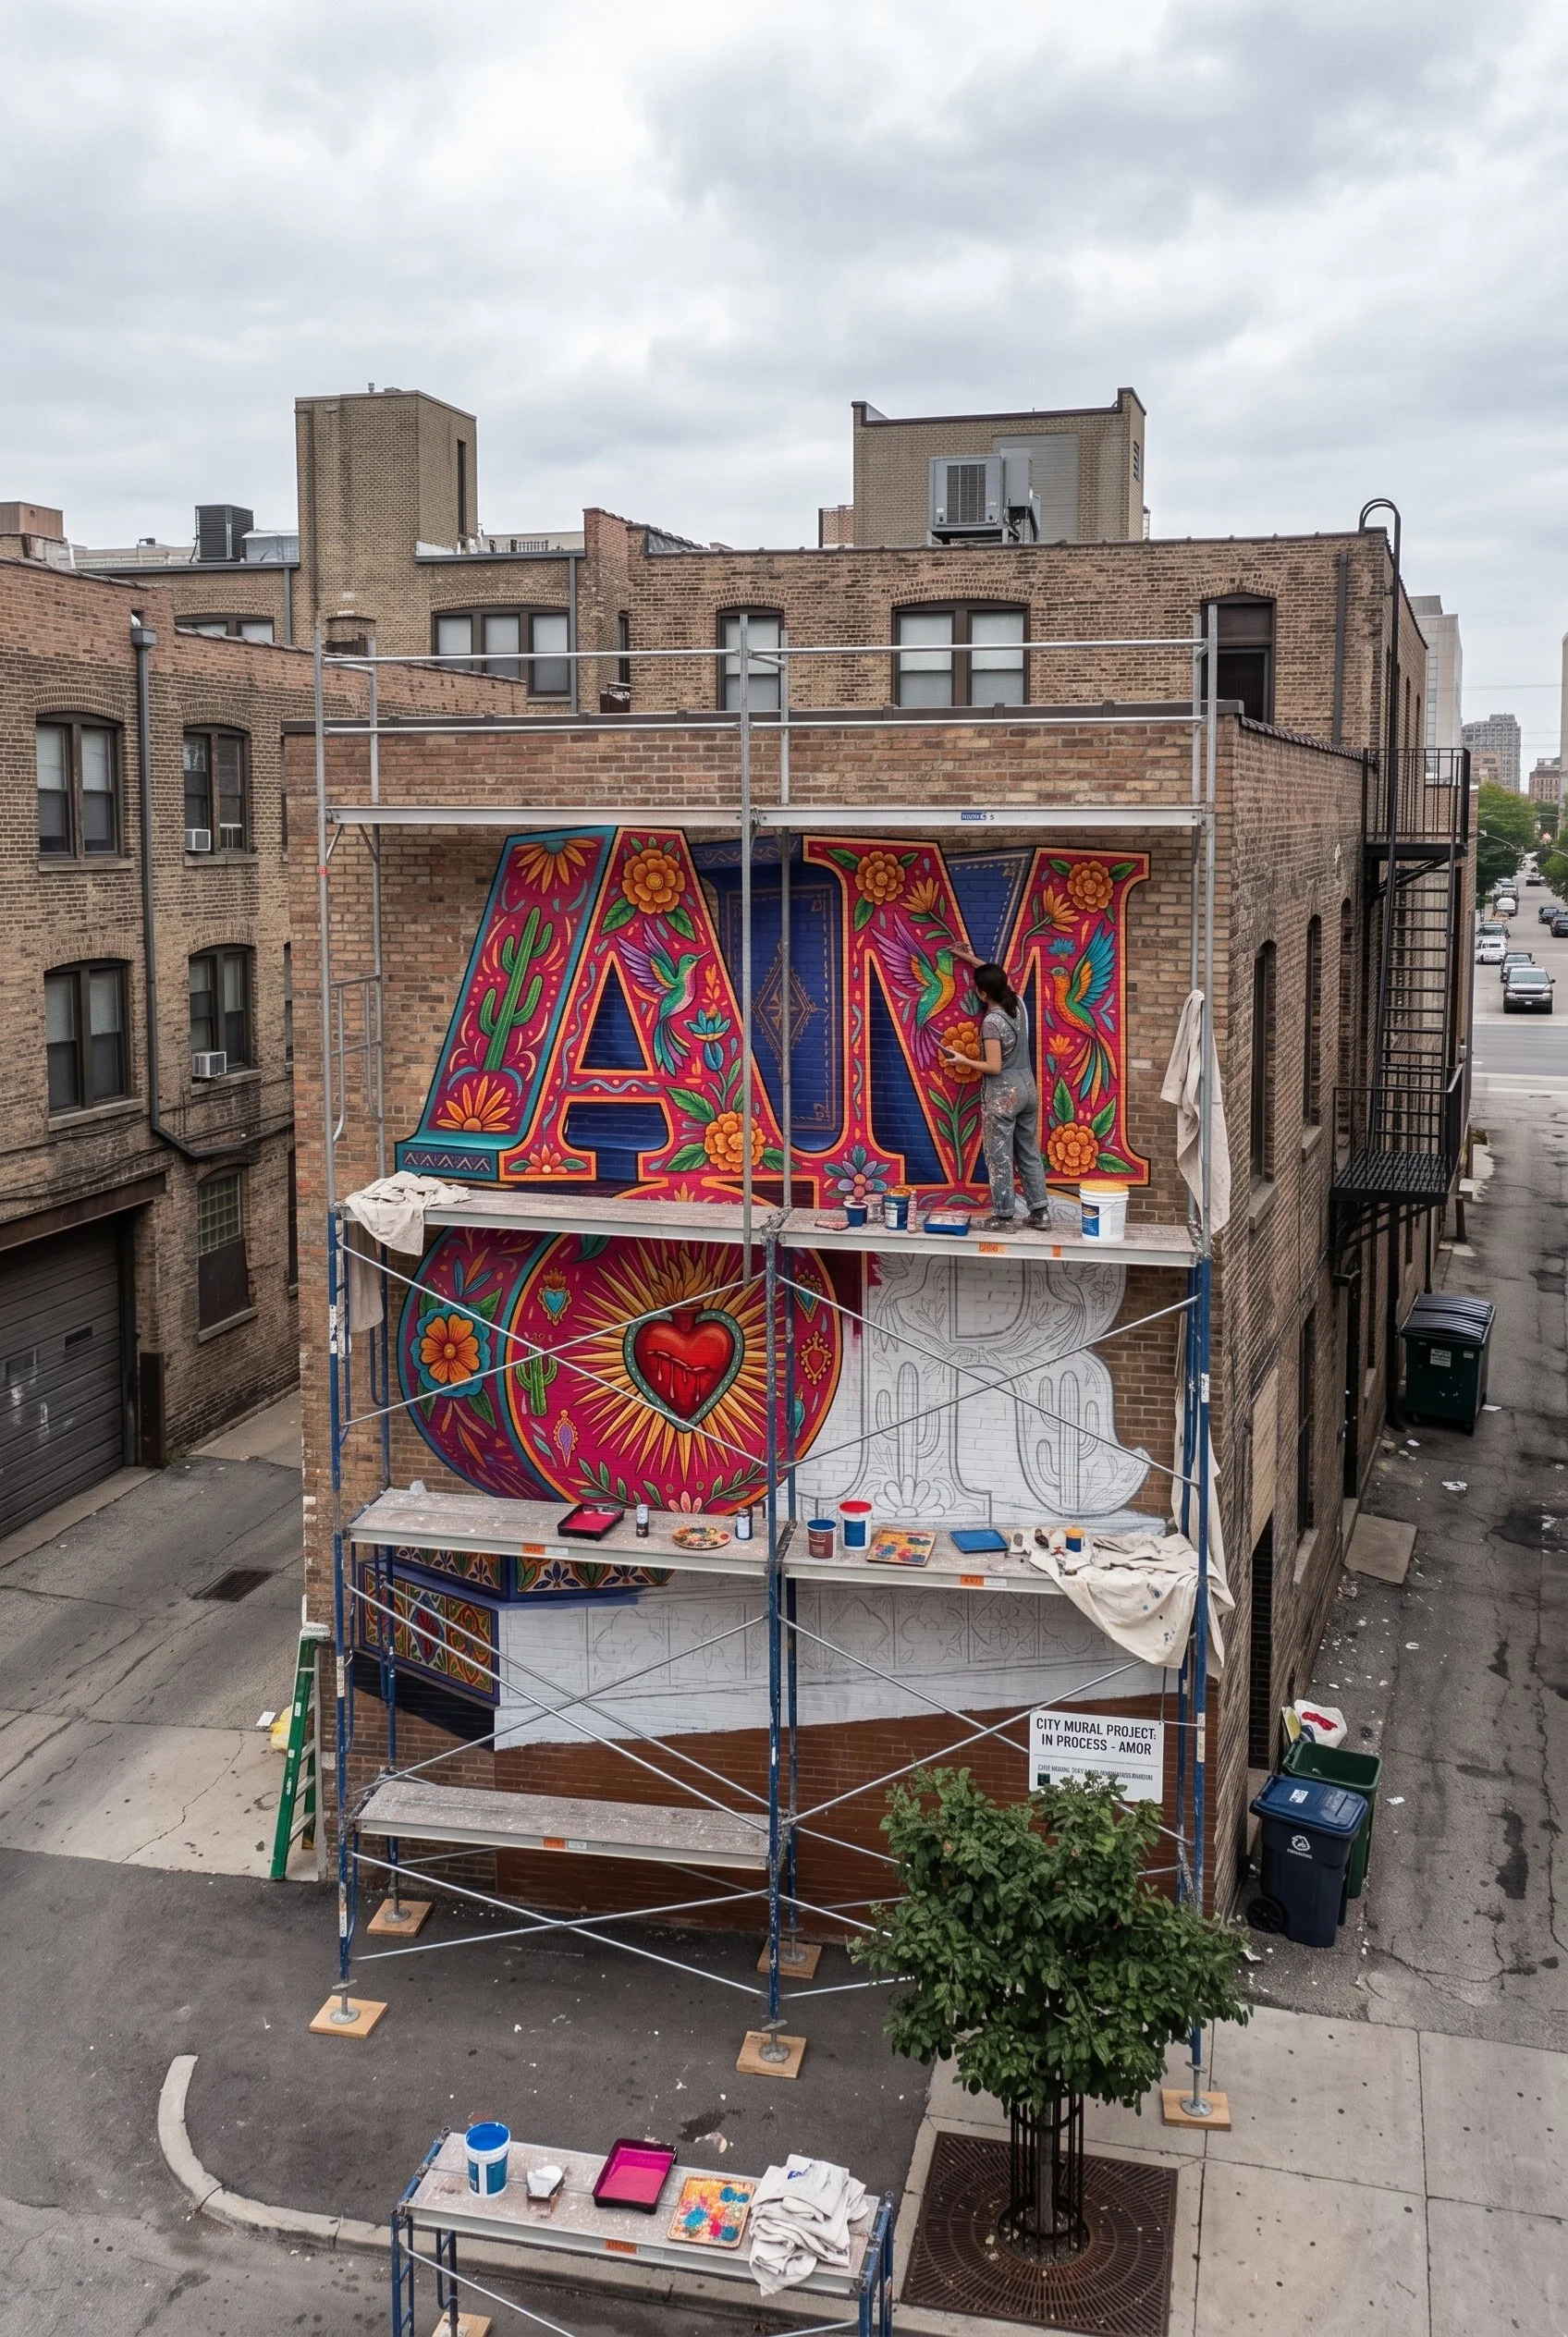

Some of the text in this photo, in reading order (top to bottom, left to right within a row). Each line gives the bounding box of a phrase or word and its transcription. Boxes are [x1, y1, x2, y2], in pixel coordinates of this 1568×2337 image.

[1035, 1718, 1157, 1740] CITY MURAL PROJECT:
[1041, 1733, 1053, 1746] IN
[1056, 1735, 1108, 1751] PROCESS
[1118, 1741, 1152, 1756] AMOR
